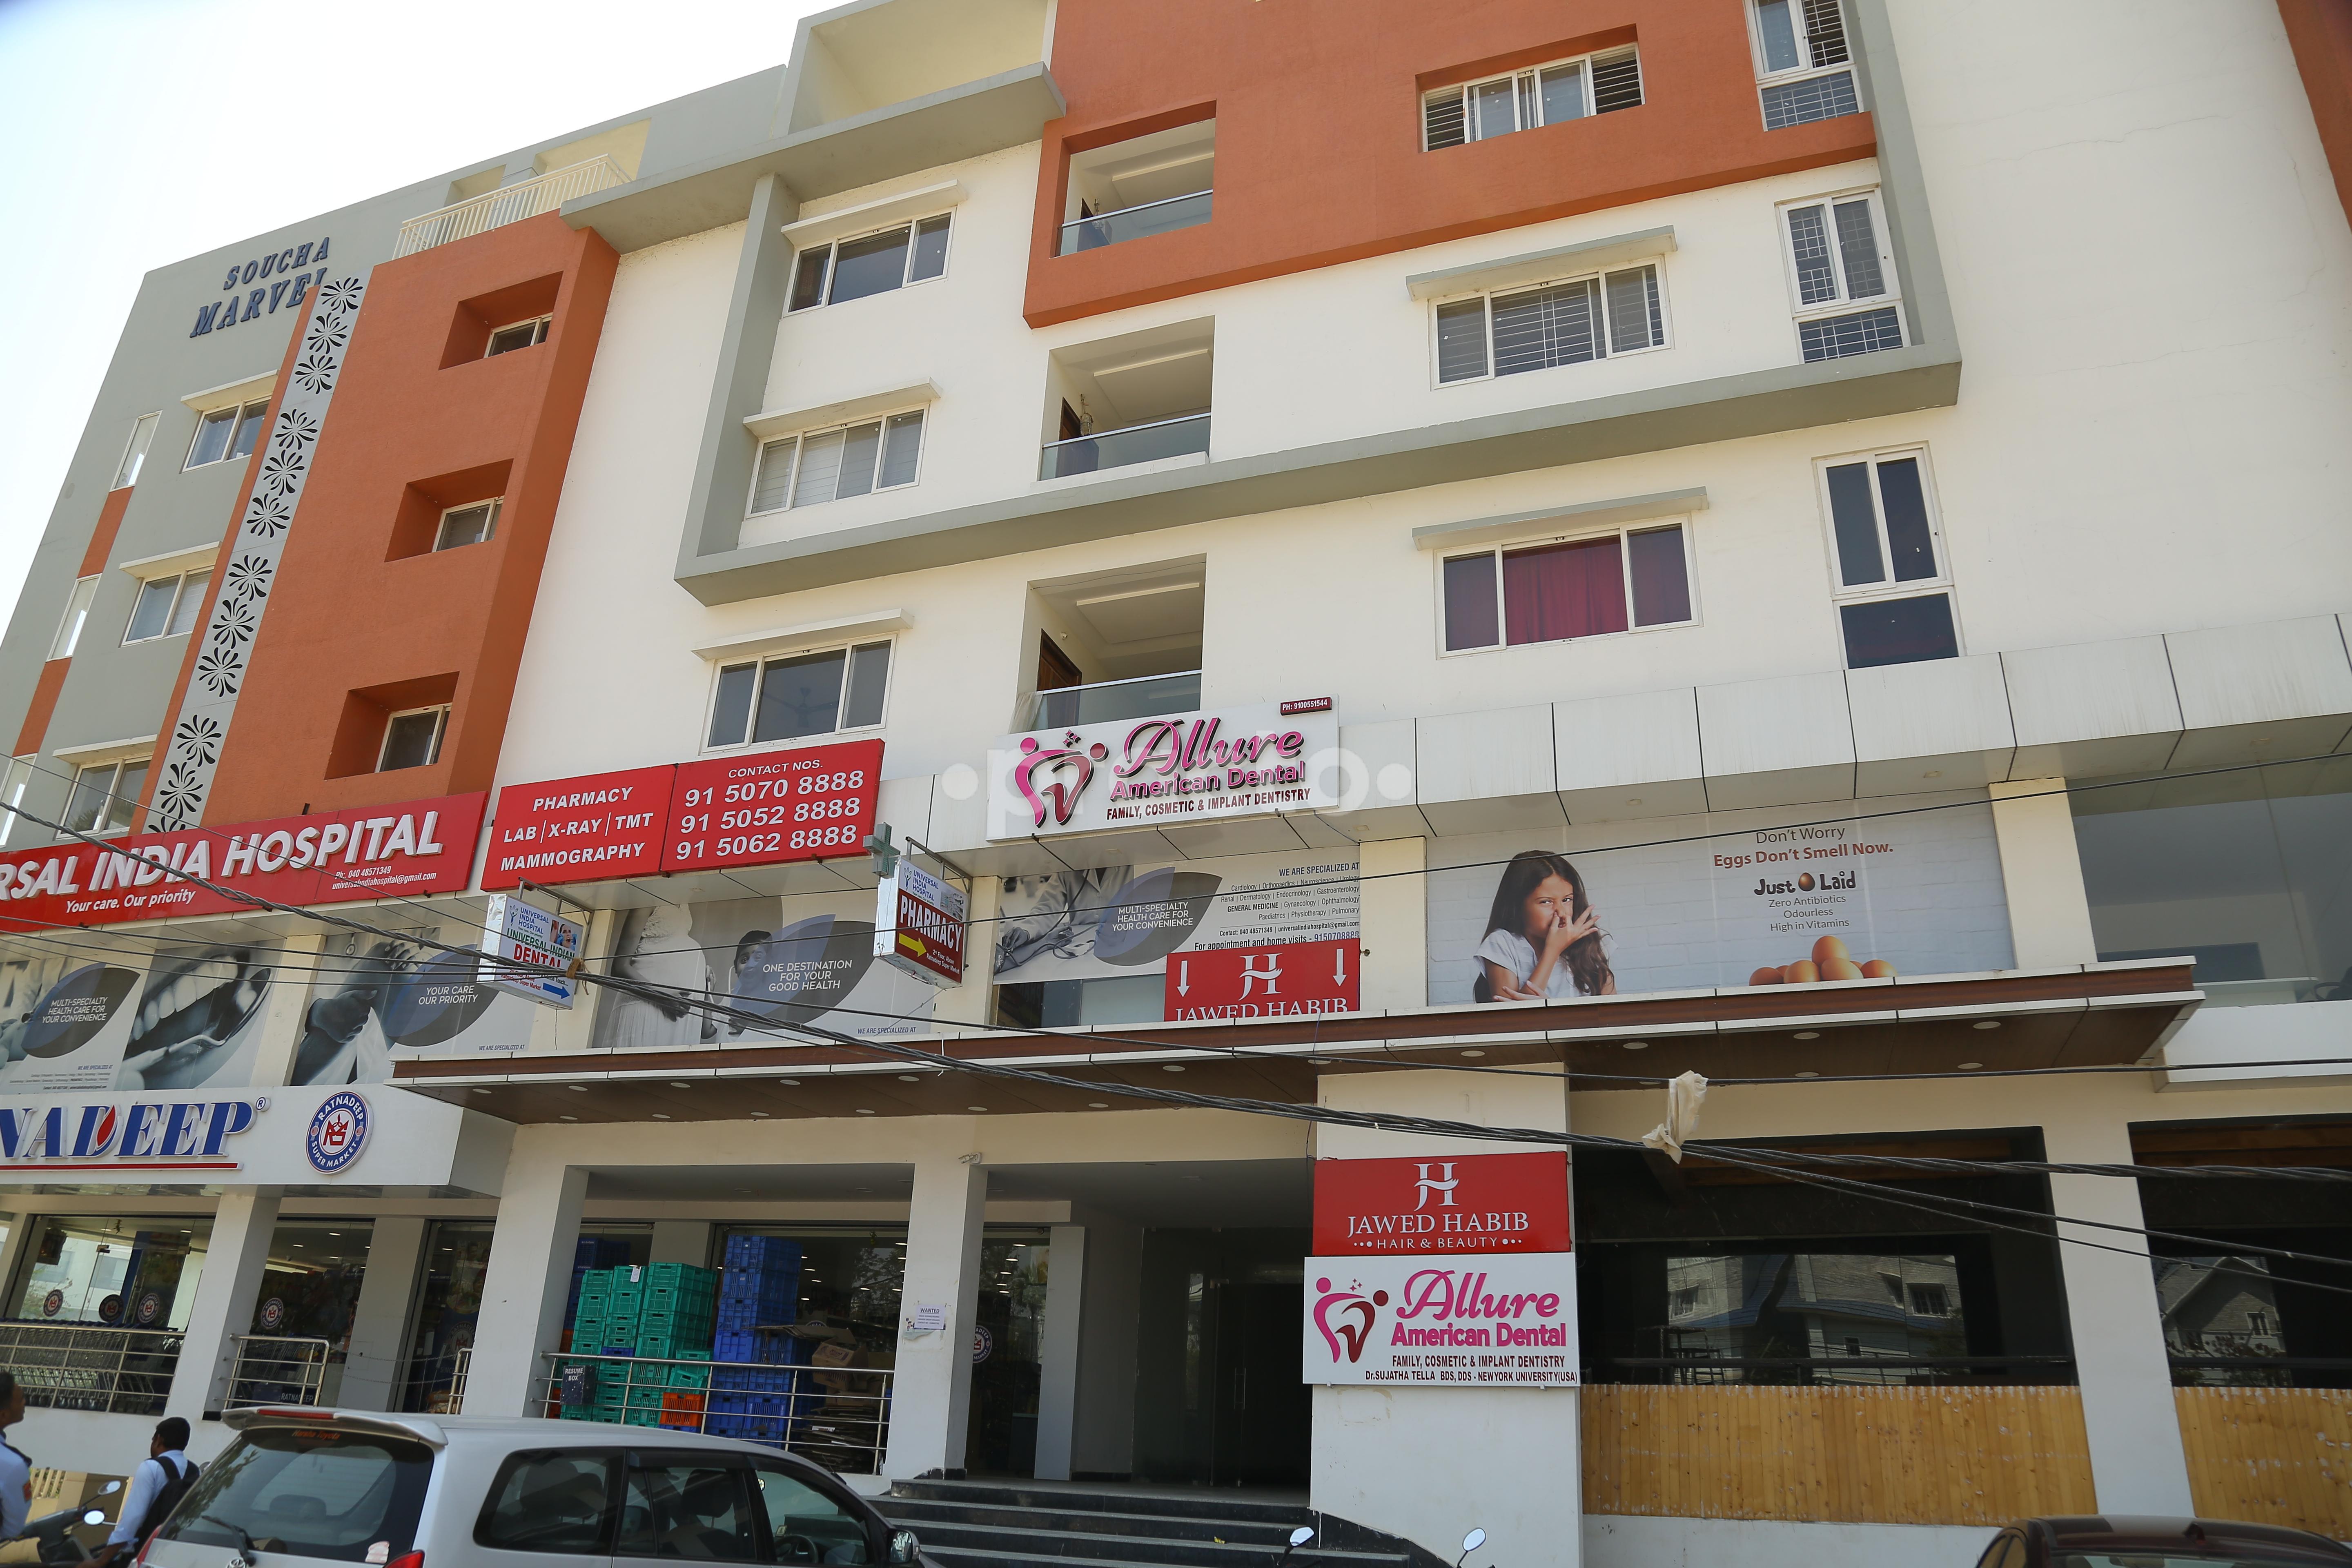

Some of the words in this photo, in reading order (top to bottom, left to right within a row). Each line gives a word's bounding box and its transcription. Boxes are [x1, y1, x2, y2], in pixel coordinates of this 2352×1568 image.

[223, 236, 330, 290] SOUCHA
[1294, 699, 1327, 709] 9100551544
[1113, 717, 1304, 776] Allure
[728, 763, 788, 779] CONTACT
[792, 759, 824, 773] NOS.
[1110, 772, 1218, 800] American
[1227, 760, 1306, 789] Dental
[685, 787, 713, 807] 91
[724, 779, 788, 804] 5070
[797, 770, 864, 795] 8888
[532, 786, 634, 812] PHARMACY
[1107, 805, 1142, 820] FAMILY,
[1145, 800, 1194, 816] COSMETIC
[1208, 794, 1251, 810] IMPLANT
[1254, 788, 1311, 805] DENTISTRY
[681, 813, 710, 834] 91
[720, 806, 784, 831] 5052
[793, 797, 860, 822] 8888
[504, 822, 537, 844] LAB
[548, 817, 602, 837] X-RAY
[615, 813, 654, 831] TMT
[1800, 827, 1845, 840] Worry
[676, 840, 705, 860] 91
[716, 833, 780, 857] 5062
[789, 824, 857, 849] 8888
[89, 840, 210, 892] INDIA
[221, 810, 443, 878] HOSPITAL
[500, 842, 646, 871] MAMMOGRAPHY
[1714, 854, 1752, 869] Eggs
[1803, 844, 1848, 859] Smell
[1853, 842, 1893, 855] Now.
[348, 869, 360, 878] 040
[361, 866, 391, 877] 48571349
[1292, 867, 1305, 875] ARE
[1307, 863, 1349, 874] SPECIALIZED
[913, 870, 938, 889] UNIVERSAL
[913, 877, 927, 889] INDIA
[1263, 880, 1295, 889] Orthopaedics
[1754, 878, 1796, 895] Just
[1820, 870, 1856, 891] Laid
[913, 884, 934, 901] HOSPITAL
[1240, 893, 1271, 902] Dermatology
[1276, 889, 1312, 898] Endocrinology
[1317, 885, 1360, 895] Gastroenterology
[66, 900, 91, 913] Your
[93, 898, 119, 910] care.
[124, 895, 146, 908] Our
[149, 889, 196, 907] priority
[1119, 902, 1188, 914] MULTI-SPECIALTY
[1227, 904, 1251, 912] GENERAL
[1253, 902, 1278, 910] MEDICINE
[1284, 900, 1316, 909] Gynaecology
[1322, 896, 1360, 905] Ophthalmology
[1768, 899, 1791, 908] Zero
[1794, 895, 1846, 906] Antibiotics
[519, 914, 535, 924] INDIA
[521, 907, 549, 924] UNIVERSAL
[1118, 913, 1147, 922] HEALTH
[1149, 911, 1170, 920] CARE
[1172, 910, 1189, 918] FOR
[1292, 909, 1326, 918] Physiotherapy
[1332, 906, 1359, 915] Pulmonary
[1783, 908, 1833, 918] Odourless
[519, 920, 543, 934] HOSPITAL
[900, 895, 962, 952] PHARMACY
[1136, 918, 1193, 929] CONVENIENCE
[1278, 921, 1359, 933] universalindiahospital@gmail.com
[1770, 923, 1793, 933] High
[1806, 918, 1849, 929] Vitamins
[507, 928, 547, 952] UNIVERSAL
[550, 944, 575, 961] INDIAN
[1195, 942, 1205, 951] For
[1208, 939, 1250, 950] appointment
[1252, 938, 1265, 947] and
[1267, 936, 1286, 946] home
[1288, 935, 1307, 943] visits
[763, 963, 784, 973] ONE
[787, 960, 852, 971] DESTINATION
[927, 953, 941, 966] Ratnadeep
[942, 961, 950, 970] Super
[950, 965, 960, 975] Market
[780, 973, 800, 981] FOR
[804, 971, 831, 980] YOUR
[426, 987, 449, 996] YOUR
[452, 985, 475, 994] CARE
[768, 982, 799, 992] GOOD
[802, 980, 840, 990] HEALTH
[51, 997, 108, 1007] MULTI-SPECIALTY
[419, 996, 437, 1005] OUR
[439, 994, 478, 1004] PRIORITY
[1266, 998, 1348, 1017] HABIB
[42, 1015, 60, 1023] YOUR
[61, 1013, 107, 1022] CONVENIENCE
[48, 1007, 72, 1015] HEALTH
[318, 1096, 363, 1121] RATNADEEP
[312, 1141, 326, 1166] SUPER
[326, 1141, 356, 1167] MARKET
[1348, 1214, 1435, 1238] JAWED
[1442, 1212, 1529, 1232] HABIB
[1377, 1238, 1415, 1249] HAIR
[1438, 1237, 1497, 1248] BEAUTY
[1396, 1269, 1560, 1320] Allure
[1391, 1323, 1490, 1347] American
[1496, 1323, 1566, 1347] Dental
[1392, 1355, 1422, 1369] FAMILY,
[1425, 1355, 1467, 1368] COSMETIC
[1479, 1355, 1515, 1368] IMPLANT
[1518, 1355, 1565, 1368] DENTISTRY
[1365, 1371, 1409, 1381] Dr.SUJATHA
[1412, 1371, 1435, 1381] TELLA
[1441, 1371, 1457, 1383] BDS,
[1458, 1371, 1472, 1381] DDS
[1516, 1371, 1577, 1384] UNIVERSITY(USA)
[281, 1393, 314, 1402] RATNAEP
